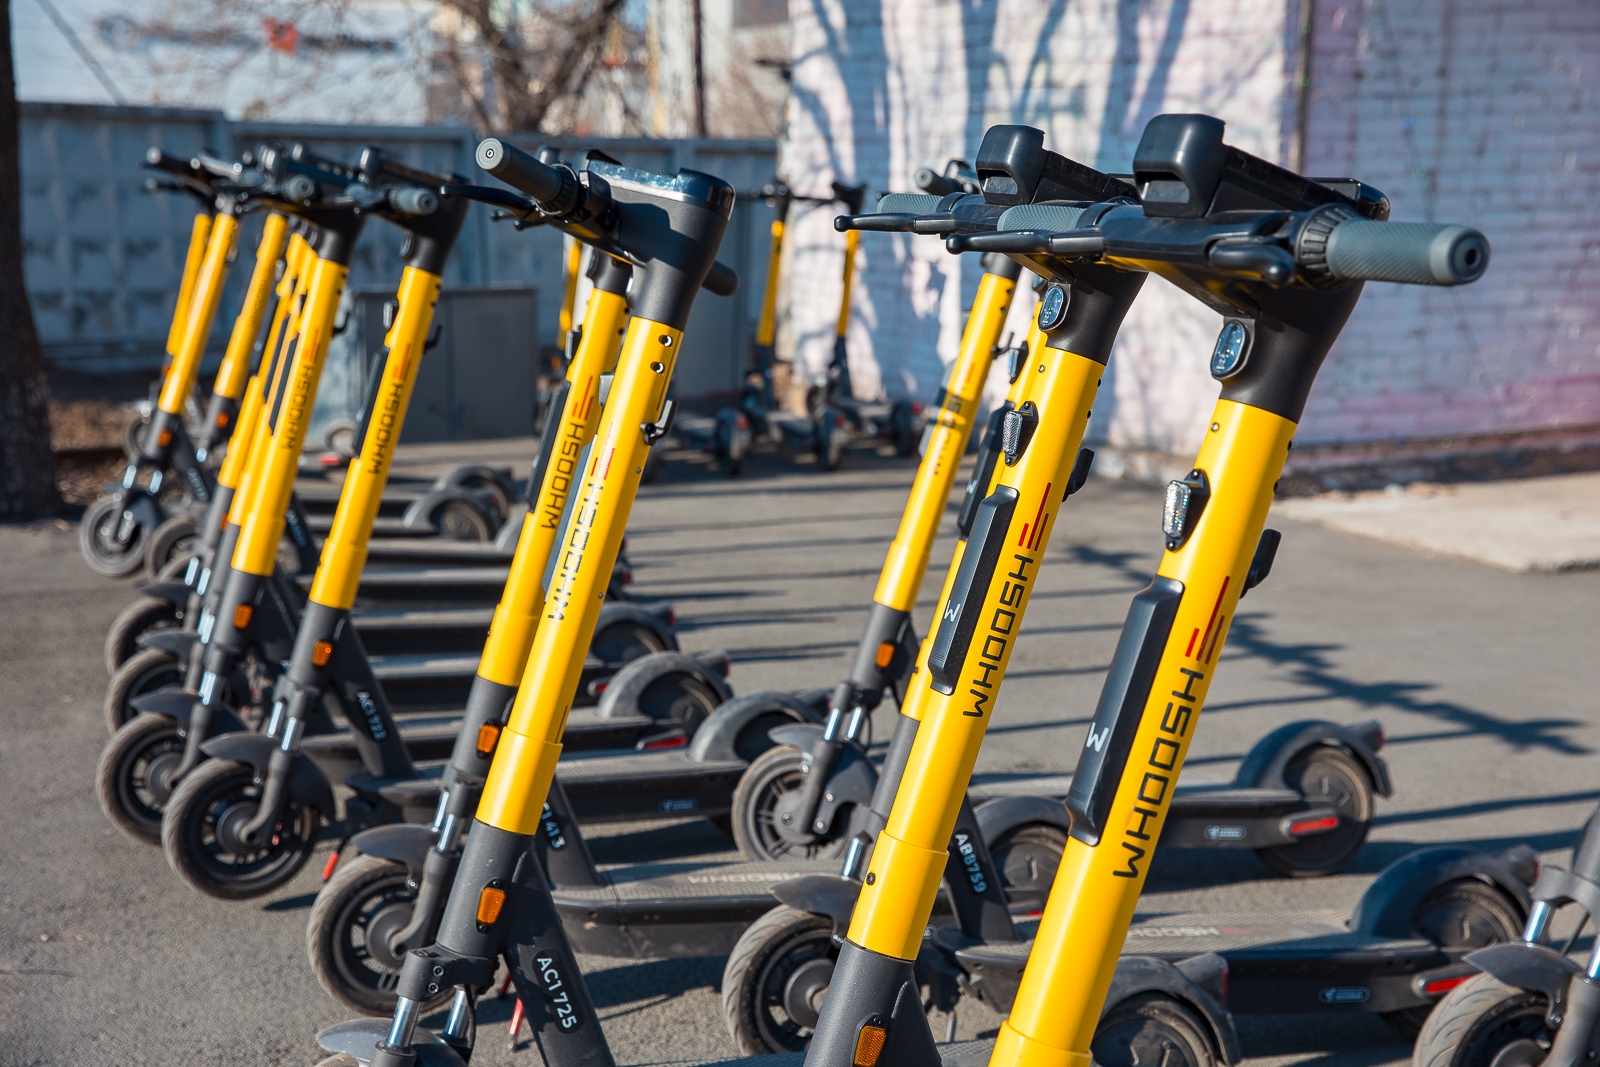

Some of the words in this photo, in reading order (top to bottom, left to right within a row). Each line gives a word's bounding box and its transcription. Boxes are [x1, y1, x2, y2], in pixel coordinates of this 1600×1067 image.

[367, 381, 405, 475] WHOOSH
[541, 422, 585, 529] WHOOSH
[548, 482, 603, 620] WHOOSH
[962, 553, 1034, 718] WHOOSH
[1086, 721, 1110, 752] W
[1112, 667, 1204, 878] WHOOSH
[536, 957, 578, 1029] AC1725
